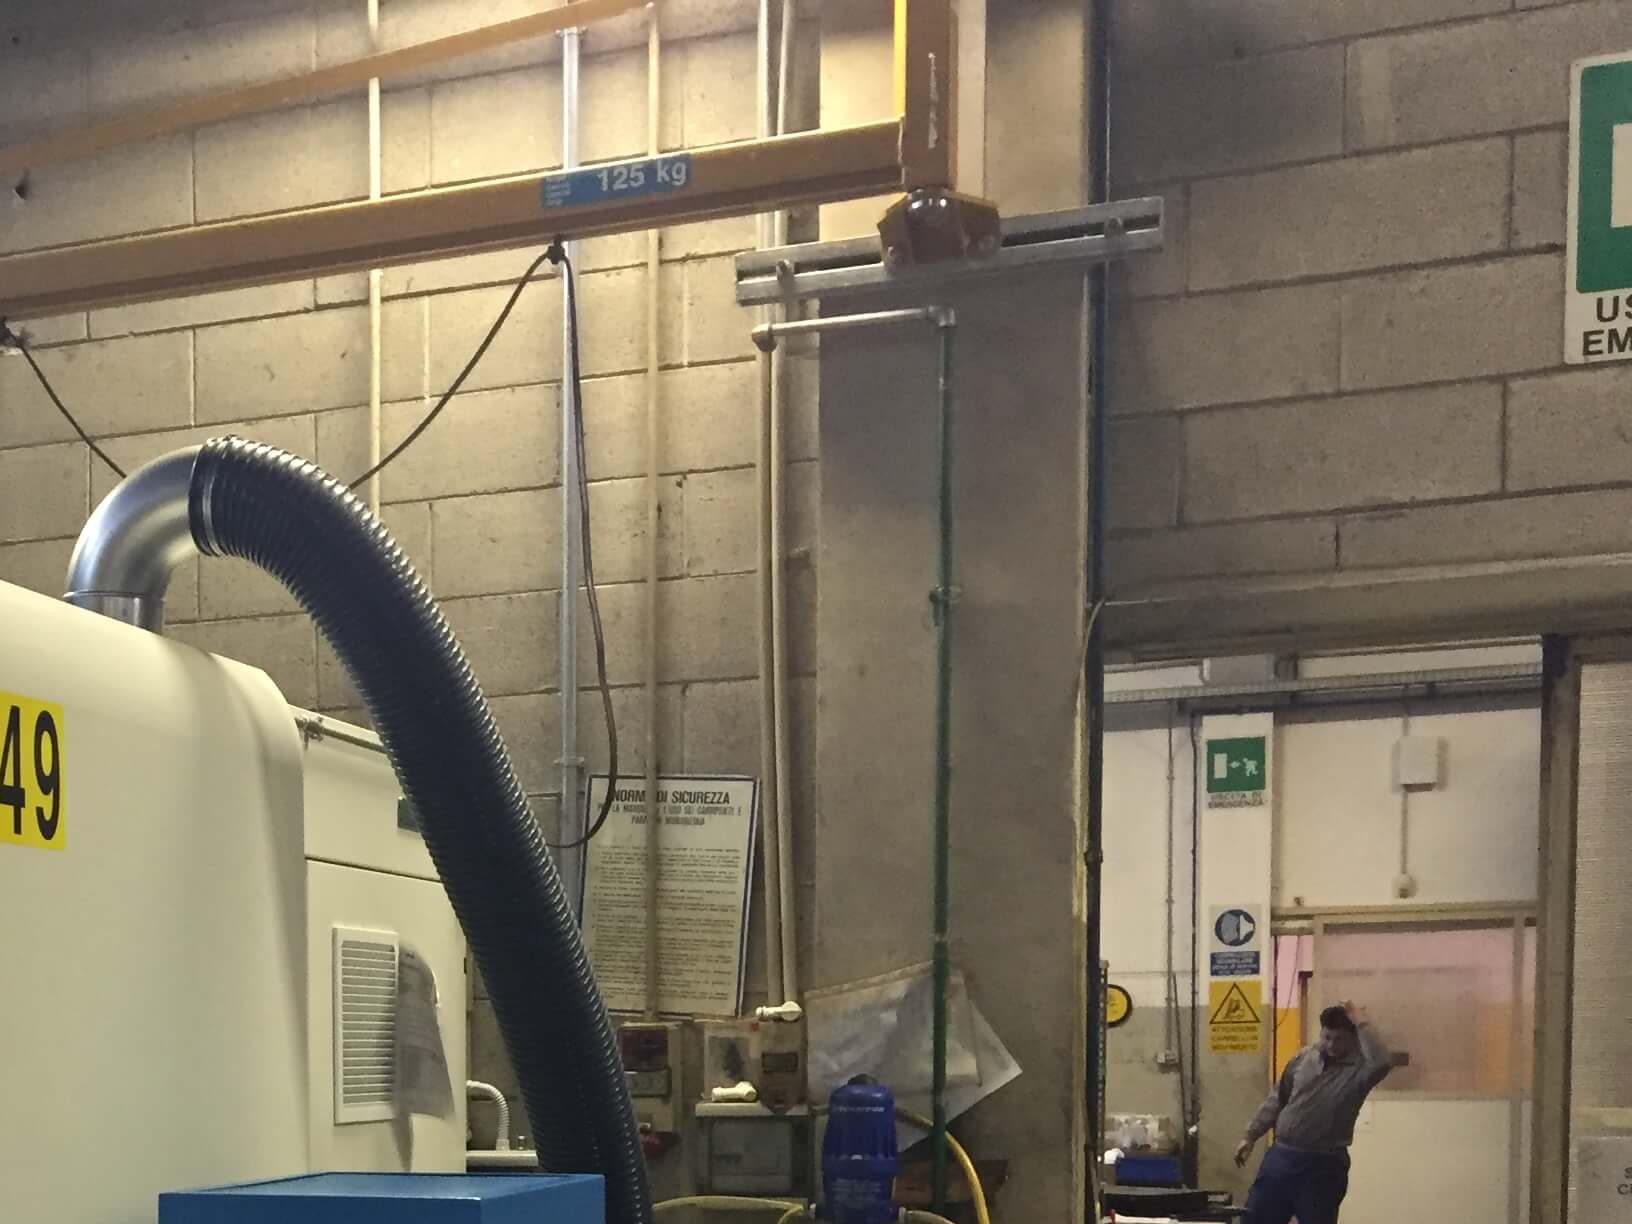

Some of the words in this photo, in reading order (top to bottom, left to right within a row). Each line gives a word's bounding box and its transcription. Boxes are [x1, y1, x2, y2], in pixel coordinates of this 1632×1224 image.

[598, 164, 645, 191] 125
[656, 160, 687, 186] kg
[672, 791, 730, 804] SICUREZZA
